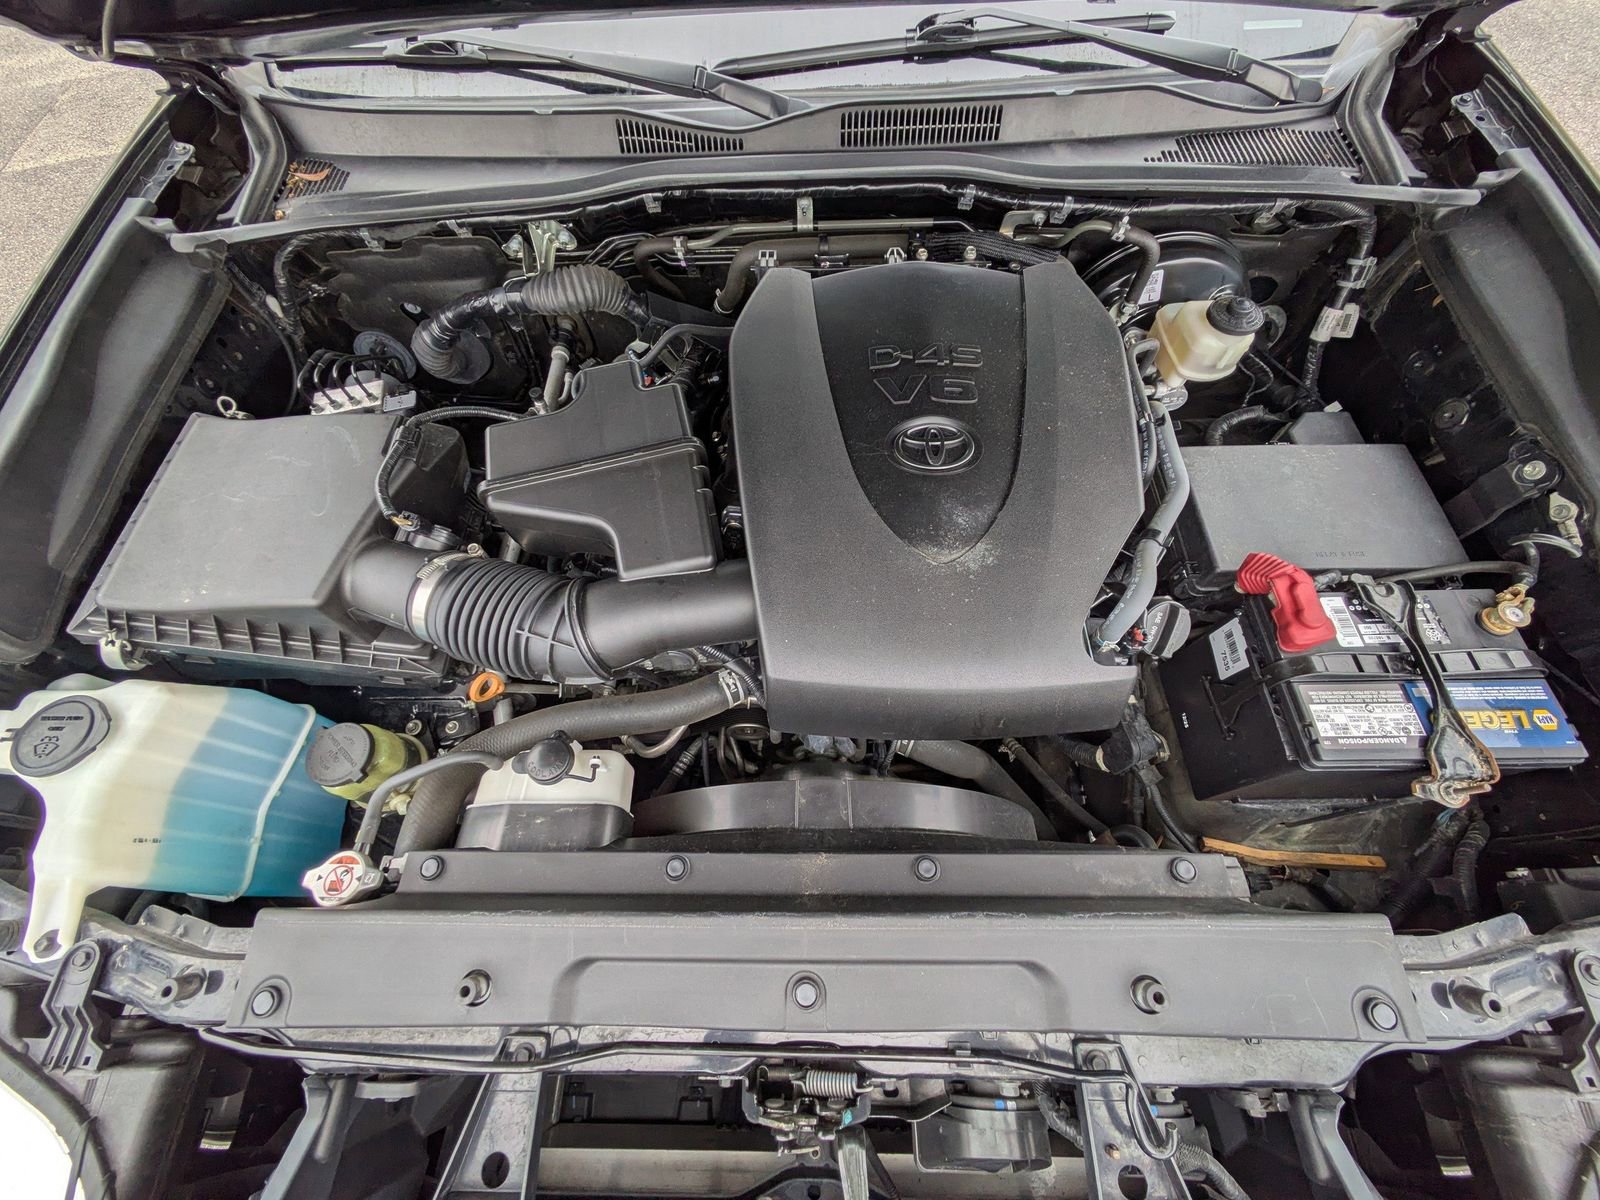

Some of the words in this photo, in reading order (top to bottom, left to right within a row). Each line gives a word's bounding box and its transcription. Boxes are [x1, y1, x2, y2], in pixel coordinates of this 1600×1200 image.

[868, 343, 983, 369] D-4S
[873, 374, 979, 404] V6
[1220, 650, 1231, 672] 7535
[1457, 709, 1533, 730] LEGE
[1537, 714, 1555, 725] NAPA
[527, 760, 565, 778] COOLANT
